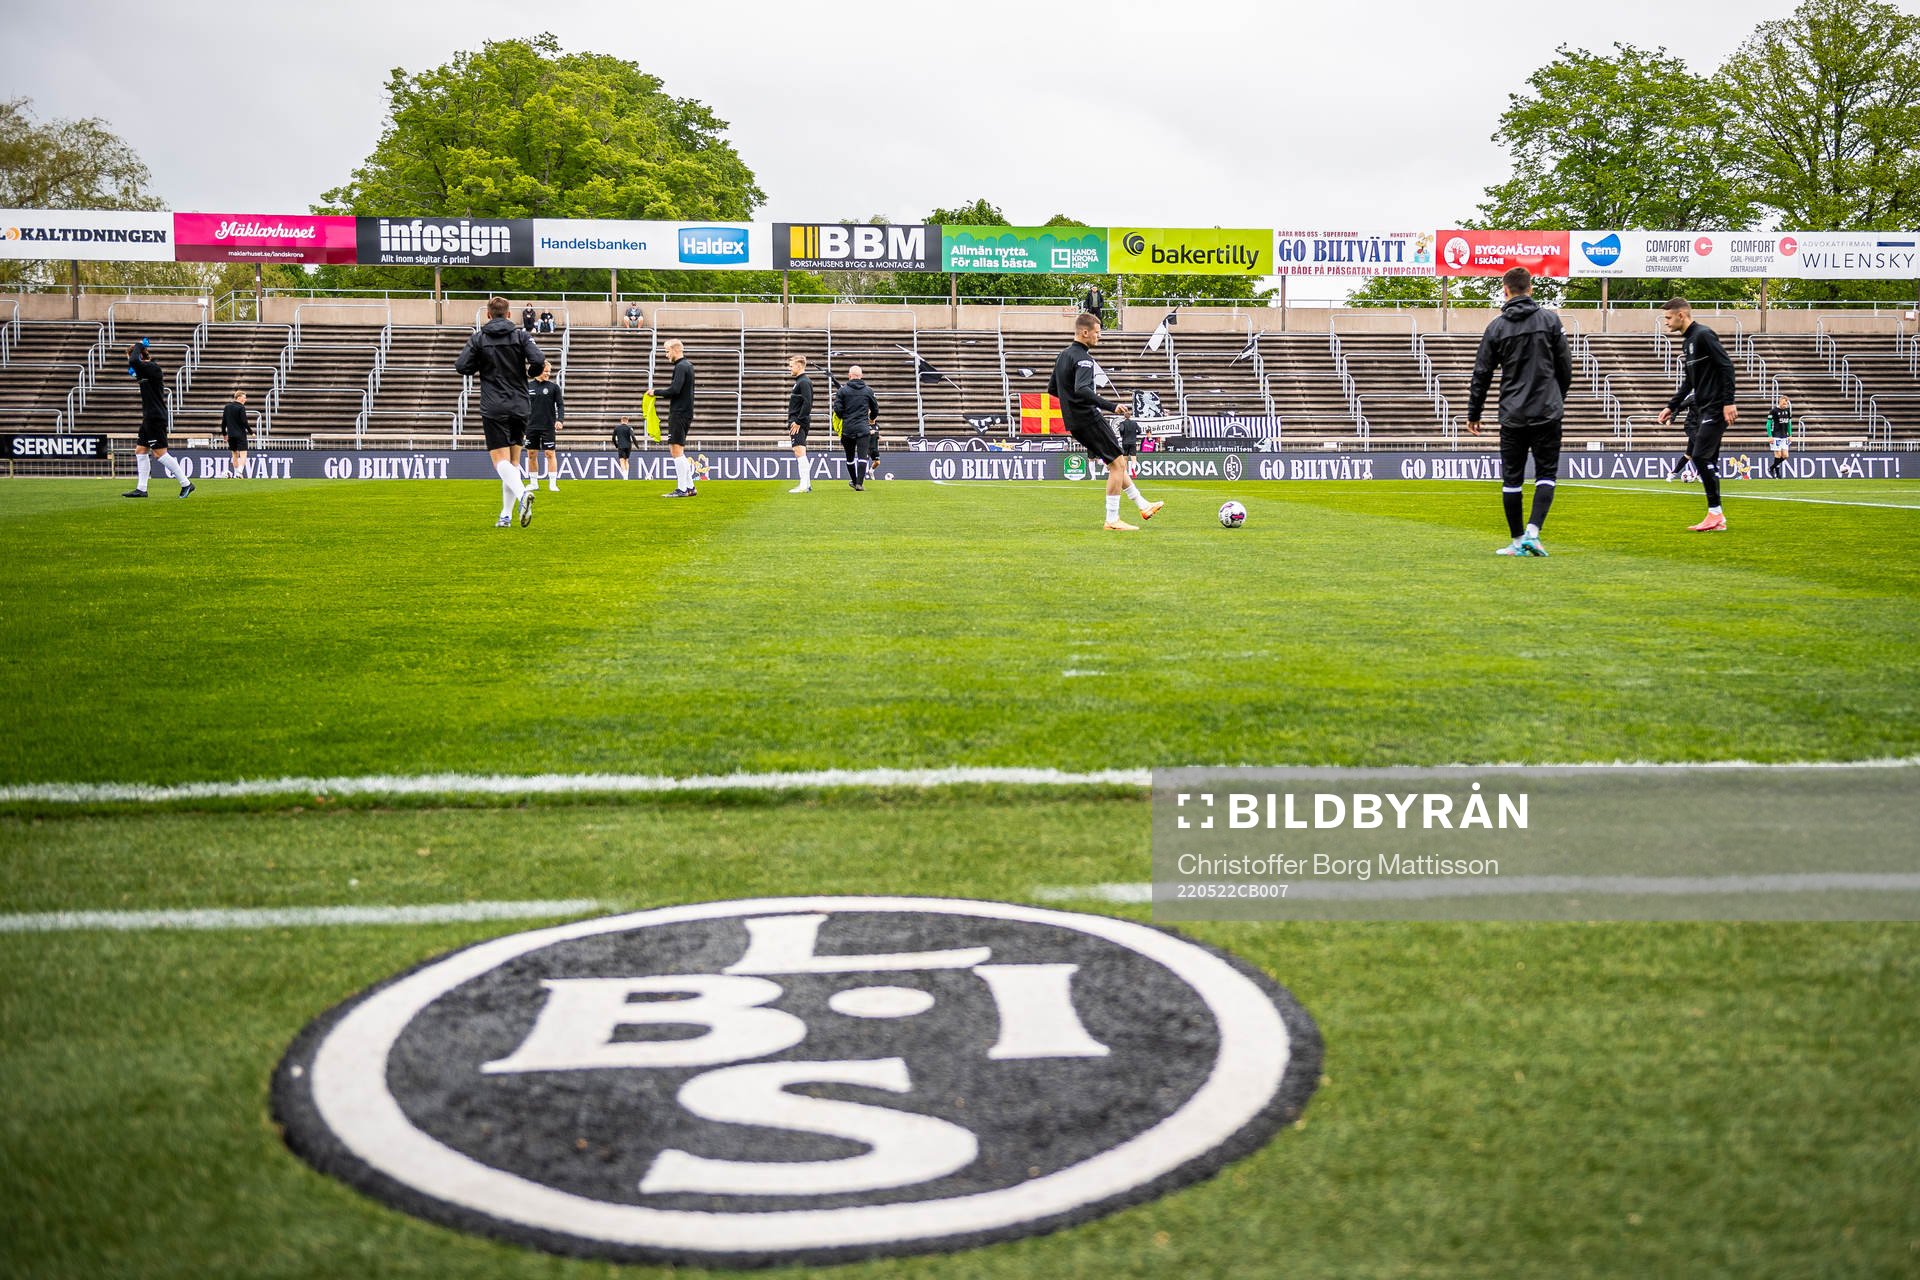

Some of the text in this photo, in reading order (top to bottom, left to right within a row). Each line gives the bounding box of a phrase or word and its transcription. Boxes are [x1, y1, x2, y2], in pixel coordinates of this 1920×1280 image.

[215, 220, 316, 240] Mäklarhuset
[380, 219, 511, 256] infosign
[541, 238, 647, 251] Handelsbanken
[684, 237, 744, 255] Haldex
[819, 226, 925, 260] BBM
[951, 245, 1028, 257] Allmän nytta.
[1279, 236, 1405, 262] GO BILTVÄTT
[1586, 247, 1617, 256] arema
[1646, 240, 1691, 253] COMFORT
[1731, 240, 1775, 253] COMFORT
[395, 255, 413, 263] inom
[415, 255, 441, 264] skyltar
[442, 255, 448, 263] &
[449, 255, 470, 264] print!
[790, 260, 844, 268] BORSTAHUSENS
[875, 261, 912, 269] MONTAGE
[951, 257, 1037, 268] För allas bästa.
[1151, 244, 1259, 270] bakertilly
[1479, 256, 1504, 265] SKÅNE
[1803, 253, 1915, 269] WILENSKY
[1278, 266, 1288, 274] NU
[1291, 264, 1312, 275] BÅDE
[1315, 265, 1324, 275] PÅ
[1374, 267, 1379, 275] &
[13, 438, 97, 455] SERNEKE
[200, 454, 293, 478] BILVÄTT
[324, 454, 449, 479] GO BILTVÄTT
[556, 452, 629, 478] ÄVEN
[930, 456, 1046, 479] GO BILTVÄTT
[1259, 456, 1373, 479] GO BILTVÄTT
[1401, 456, 1502, 478] GO BILTVÄT
[1569, 458, 1603, 478] NU
[1610, 454, 1676, 478] ÄVEN
